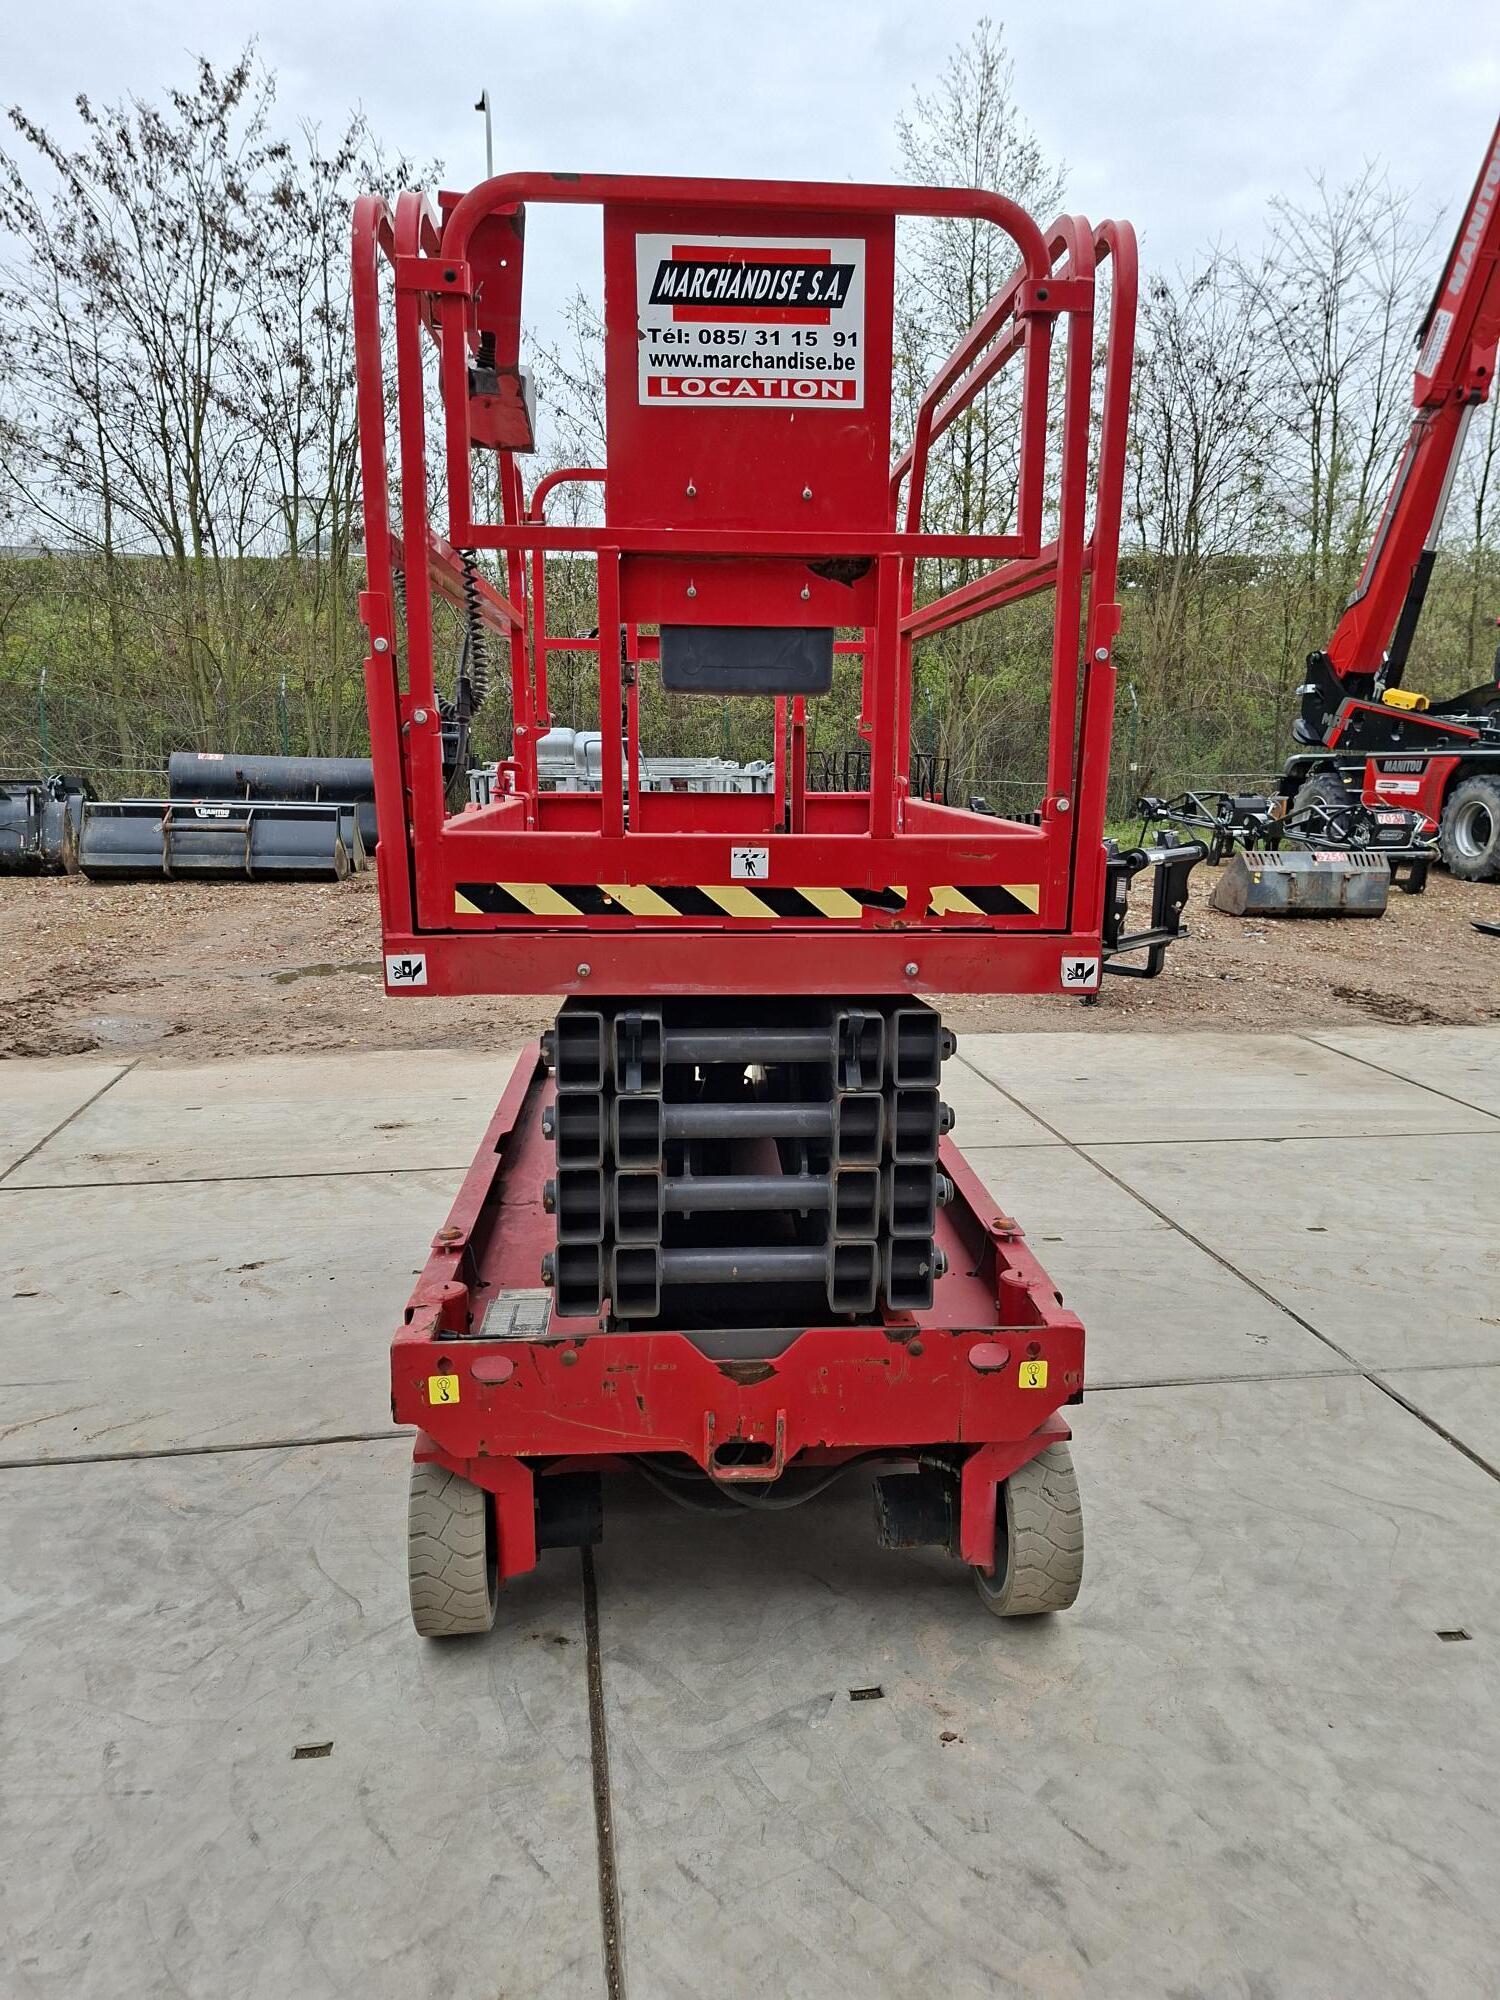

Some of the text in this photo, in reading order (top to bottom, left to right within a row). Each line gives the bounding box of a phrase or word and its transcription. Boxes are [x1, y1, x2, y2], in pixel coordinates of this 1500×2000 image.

[1447, 137, 1500, 295] MANITO
[657, 266, 844, 301] MARCHANDISE S.A.
[647, 328, 858, 347] Tél: 085/ 31 15 91
[649, 351, 856, 371] www.marchandise.be
[660, 378, 844, 399] LOCATION
[1383, 760, 1423, 772] MANITOU
